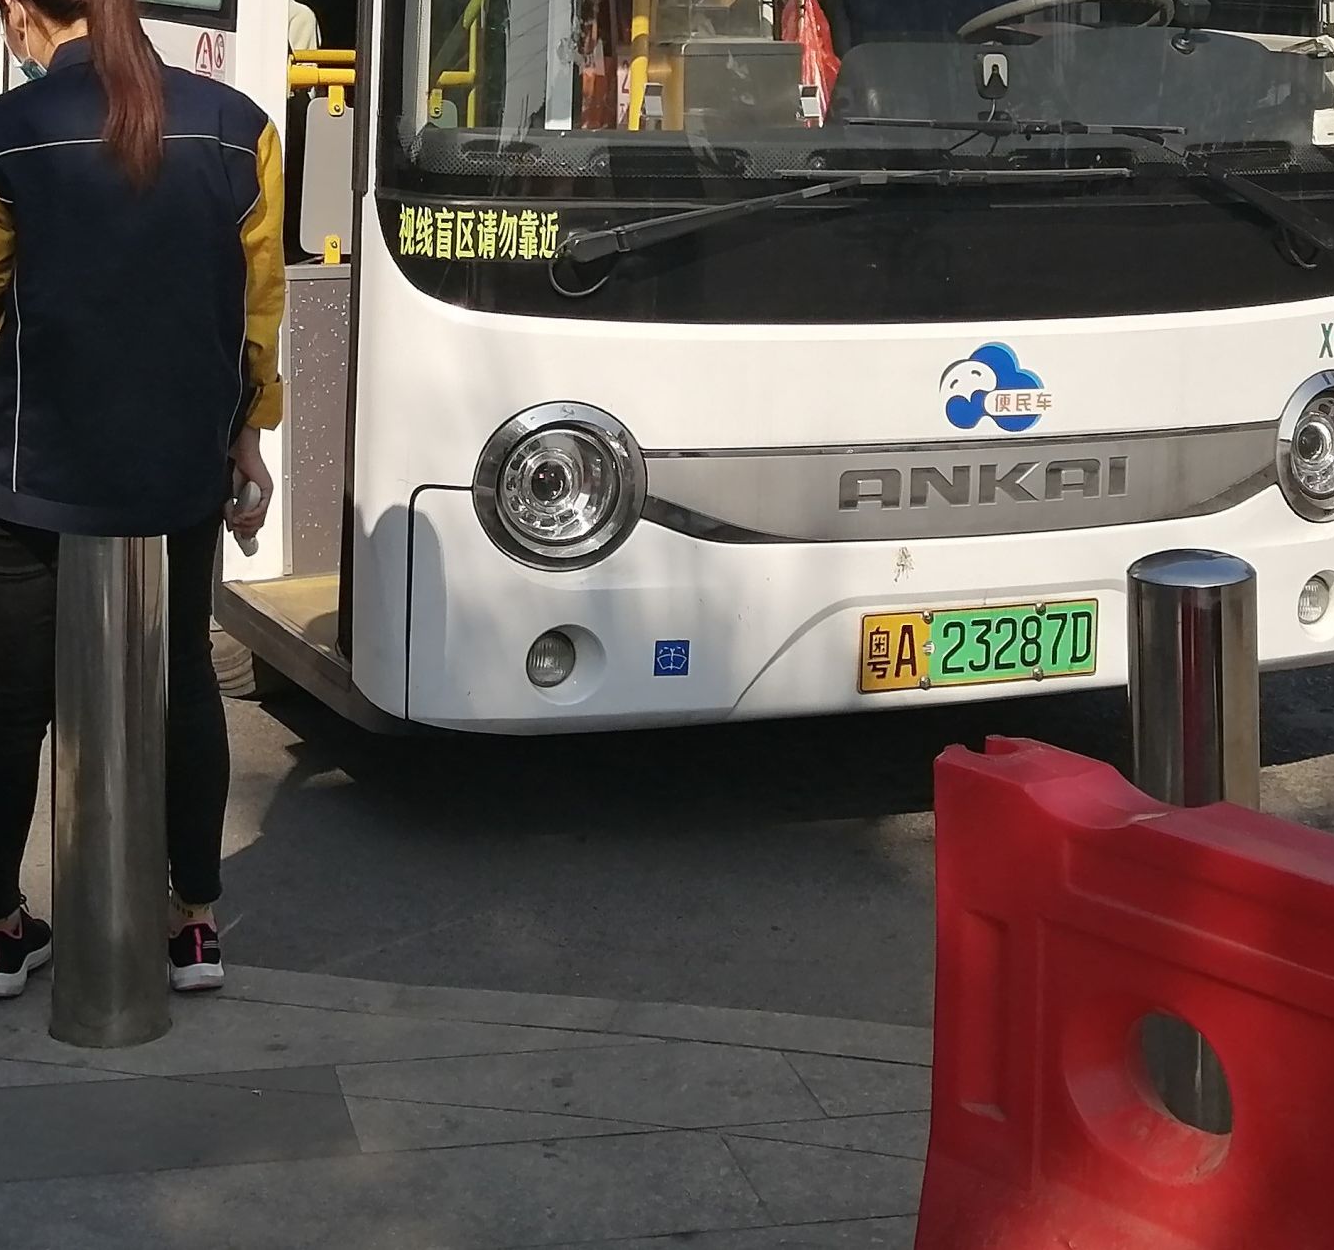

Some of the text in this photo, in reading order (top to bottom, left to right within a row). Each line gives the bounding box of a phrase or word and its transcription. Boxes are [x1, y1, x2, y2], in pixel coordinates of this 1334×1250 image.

[398, 203, 559, 260] 视线盲区请勿靠近
[994, 392, 1053, 413] 便民车
[838, 455, 1129, 513] ANKAI
[940, 610, 1093, 676] 23287D
